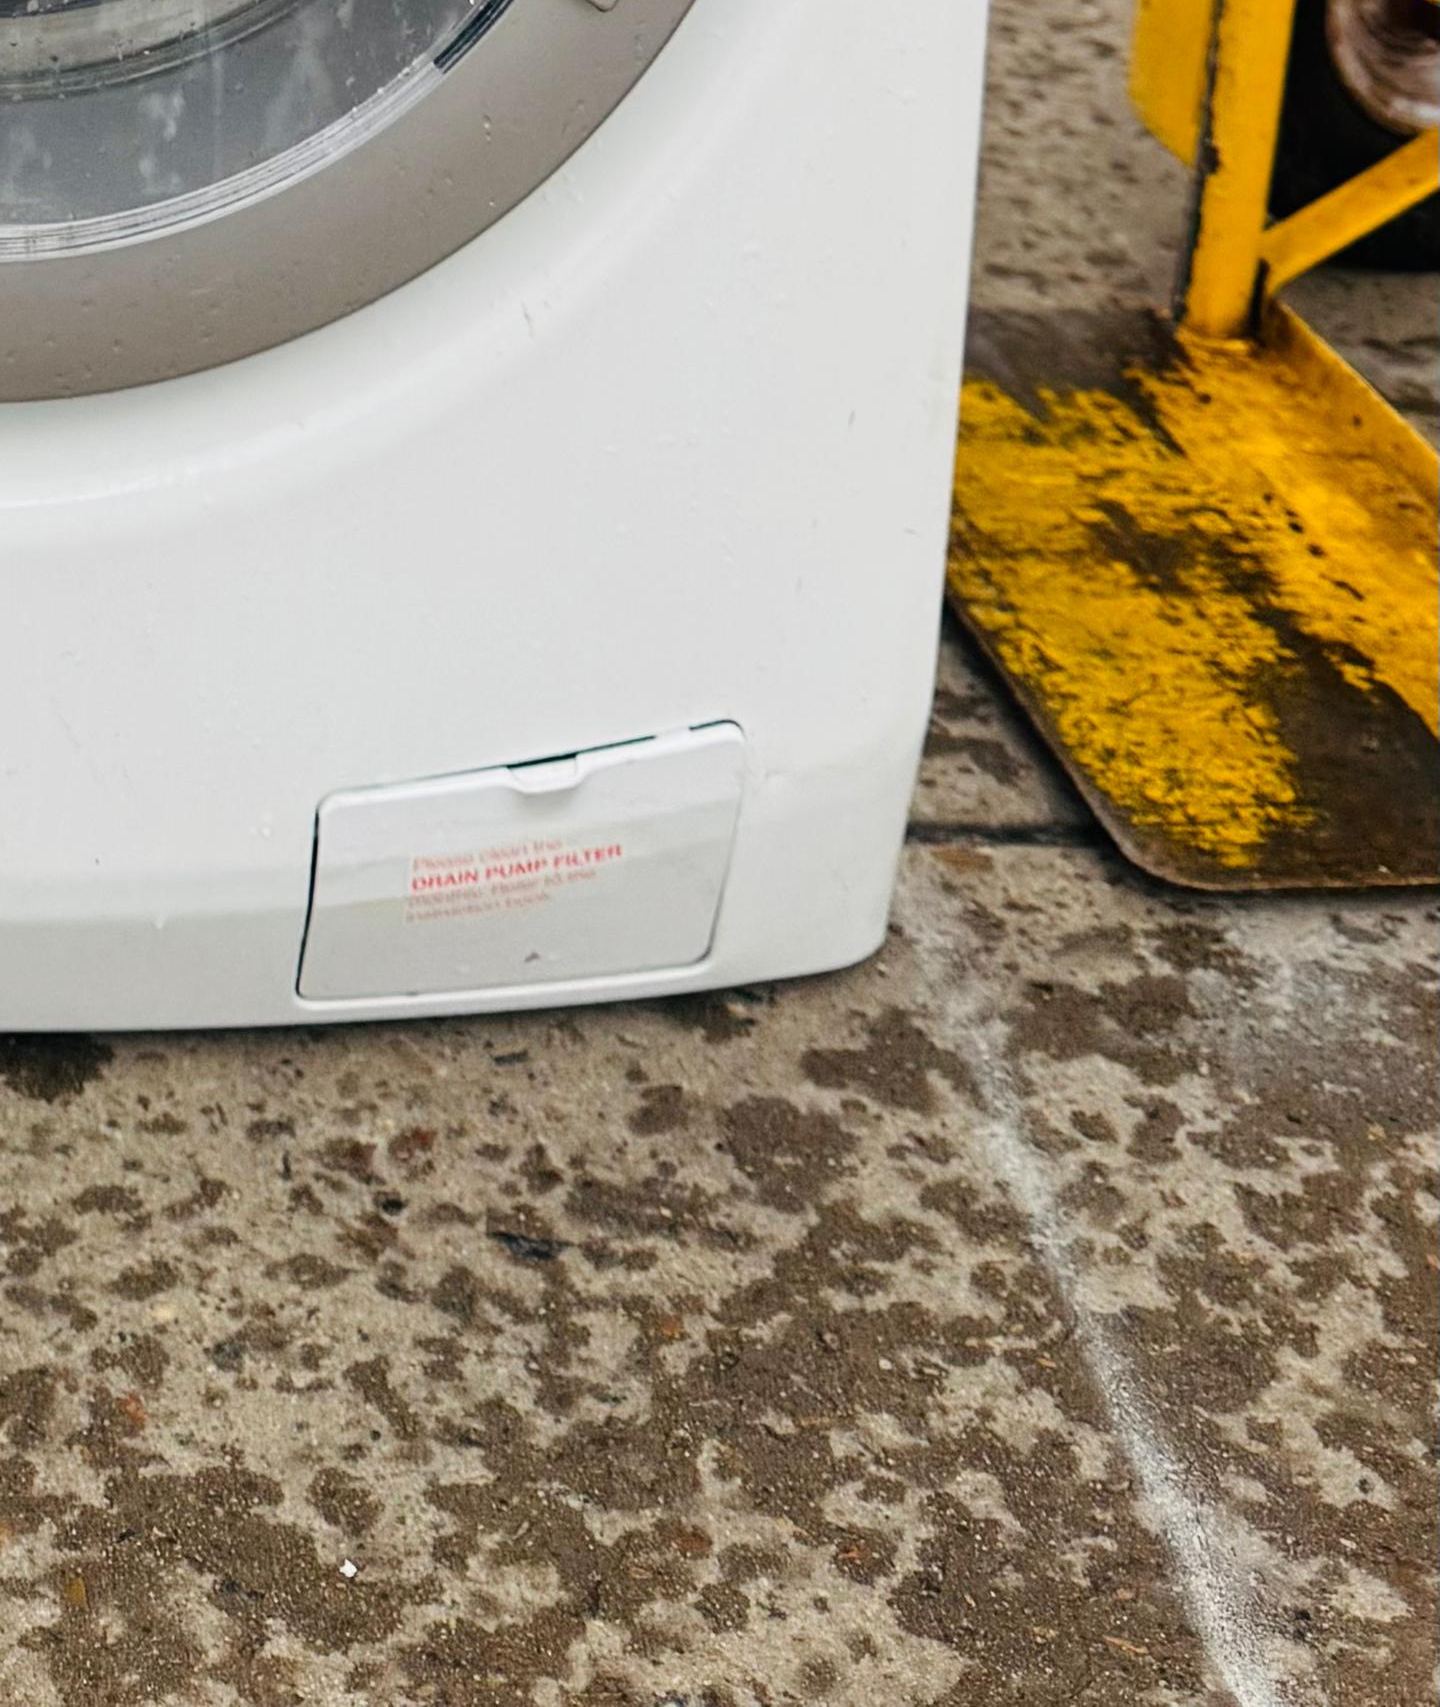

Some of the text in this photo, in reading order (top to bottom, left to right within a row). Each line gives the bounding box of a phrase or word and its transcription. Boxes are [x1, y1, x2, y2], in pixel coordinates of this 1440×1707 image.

[412, 869, 479, 891] DRAIN
[484, 858, 548, 880] PUMP
[553, 844, 622, 869] FILTER
